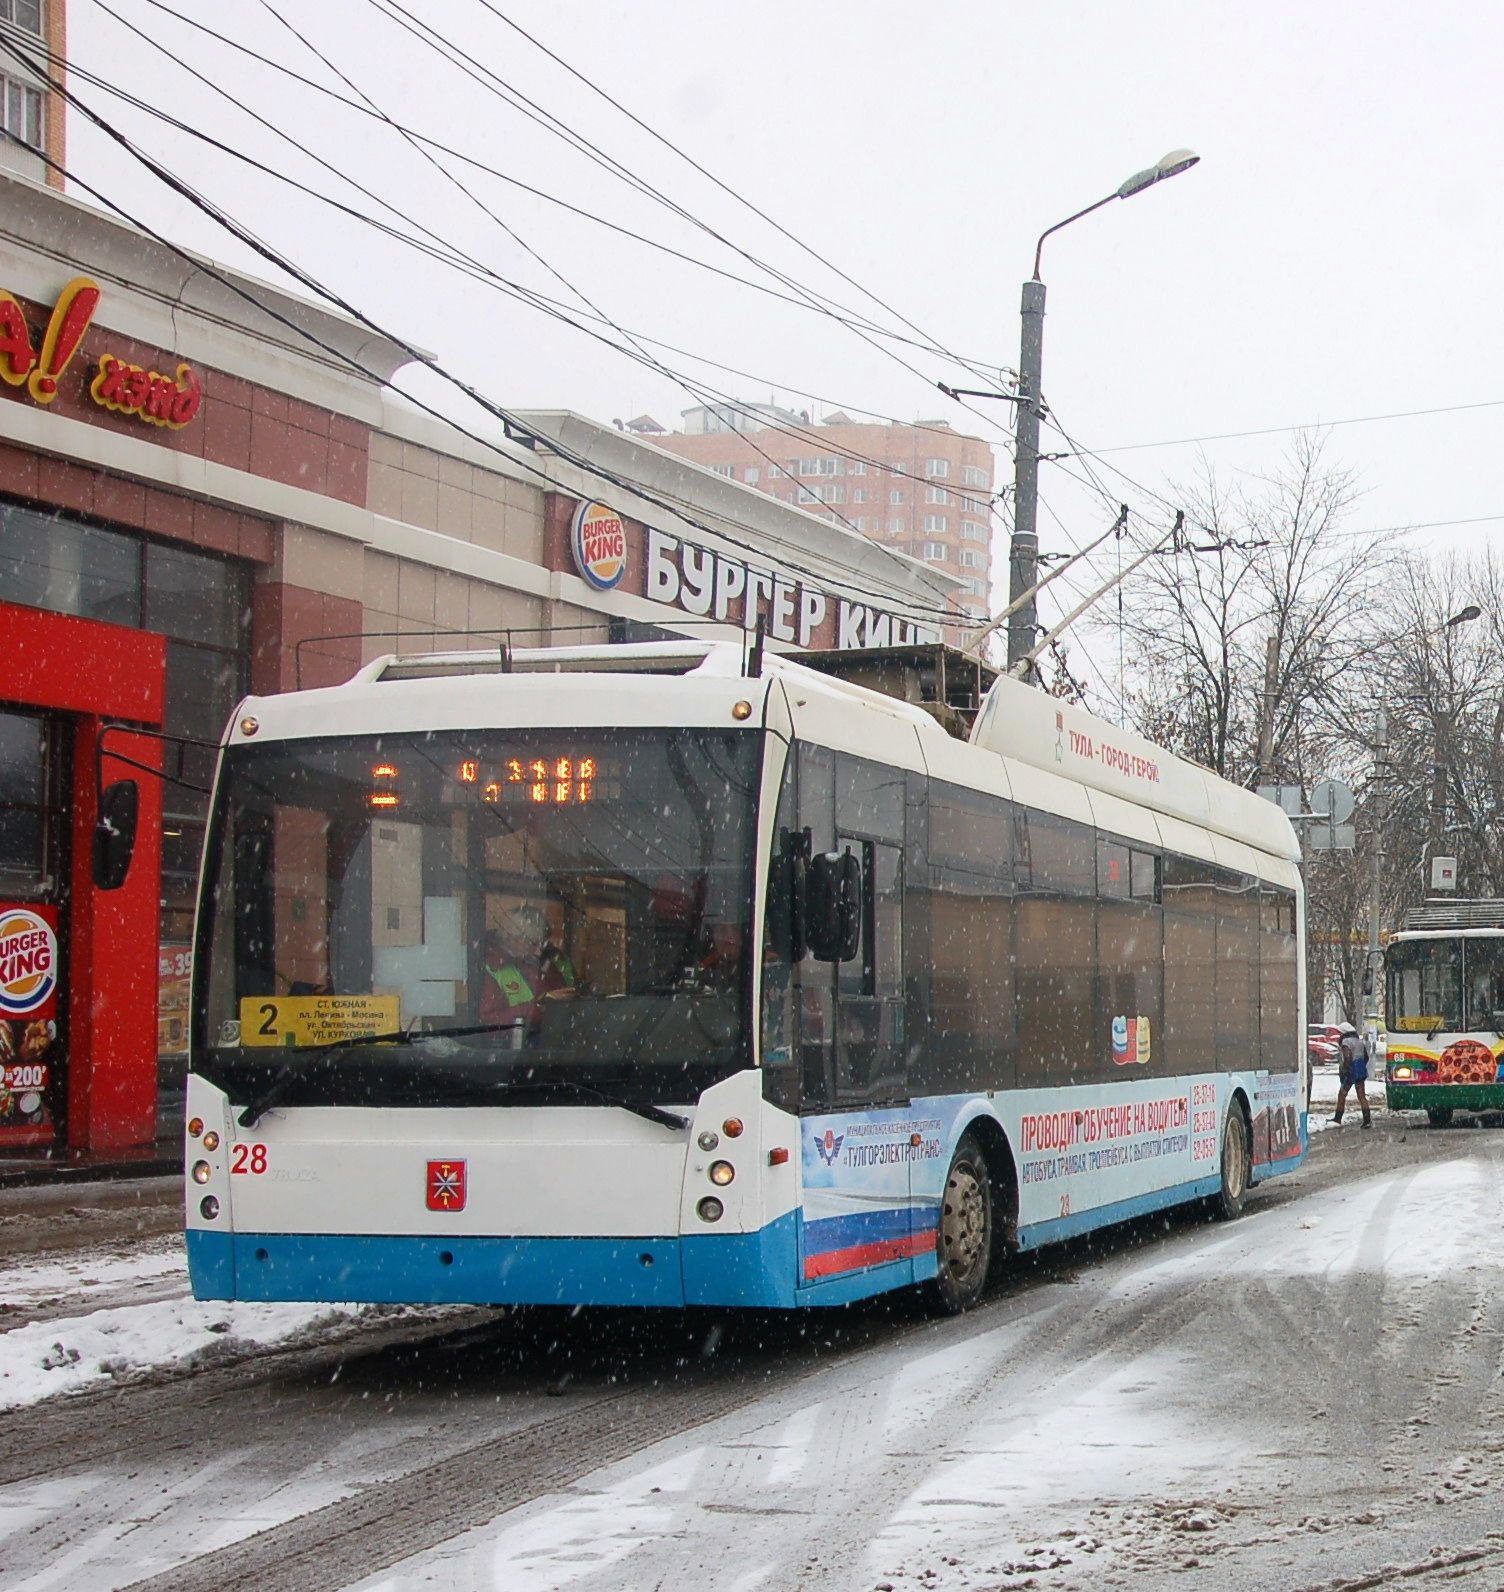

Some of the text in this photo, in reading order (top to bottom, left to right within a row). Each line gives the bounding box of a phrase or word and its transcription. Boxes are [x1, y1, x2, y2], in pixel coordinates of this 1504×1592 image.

[0, 276, 100, 404] А!
[582, 517, 622, 542] BURGER
[583, 531, 624, 563] KING
[647, 528, 827, 648] БУРГЕР
[1069, 729, 1093, 760] ТУЛА
[1101, 743, 1160, 783] ГОРОД-ГЕРОЙ
[0, 930, 48, 961] URGER
[0, 946, 50, 985] KING
[258, 1003, 279, 1036] 2
[1020, 1097, 1188, 1153] ПРОВОДИТ ОБУЧЕНИЕ НА ВОДИТЕЛЯ
[231, 1143, 268, 1175] 28
[1060, 1194, 1071, 1218] 28
